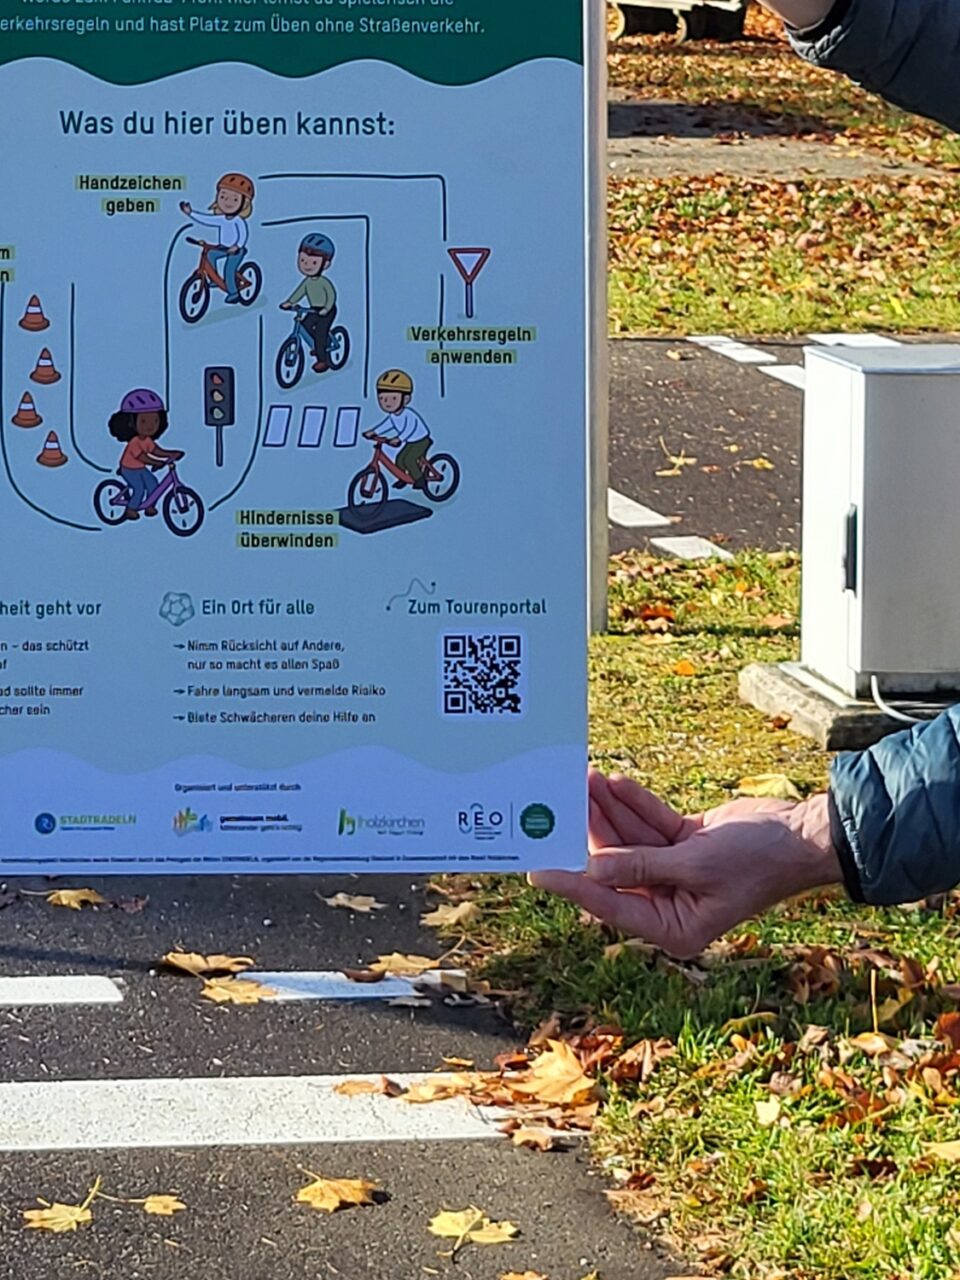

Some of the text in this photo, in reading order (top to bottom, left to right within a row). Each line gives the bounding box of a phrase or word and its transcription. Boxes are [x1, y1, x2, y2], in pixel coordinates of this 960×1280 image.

[116, 17, 144, 31] und
[150, 17, 185, 31] hast
[190, 17, 229, 31] Platz
[234, 20, 265, 31] zum
[271, 14, 309, 32] Üben
[316, 18, 354, 32] ohne
[360, 18, 484, 32] Straßenverkehr.
[60, 110, 394, 135] Was du hier üben kannst:
[79, 174, 182, 192] Handzeichen
[105, 197, 156, 215] geben
[411, 326, 533, 346] Verkehrsregeln
[430, 349, 513, 365] anwenden
[239, 509, 335, 526] Hindernisse
[240, 532, 335, 549] überwinden
[36, 600, 72, 619] geht
[77, 604, 101, 615] vor
[203, 599, 314, 614] Ein Ort für alle
[409, 599, 546, 617] Zum Tourenportal
[22, 641, 42, 651] das
[46, 640, 88, 651] schützt
[188, 640, 344, 652] Nimm Rücksicht auf Andere,
[188, 658, 339, 672] nur so macht es allen Spaß
[14, 686, 46, 696] sollte
[49, 685, 83, 696] immer
[188, 684, 385, 699] Fahre langsam und vermeide Risiko
[27, 704, 50, 715] sein
[188, 711, 375, 723] Biete Schwächeren deine Hilfe an
[60, 815, 137, 824] STADTRADELN
